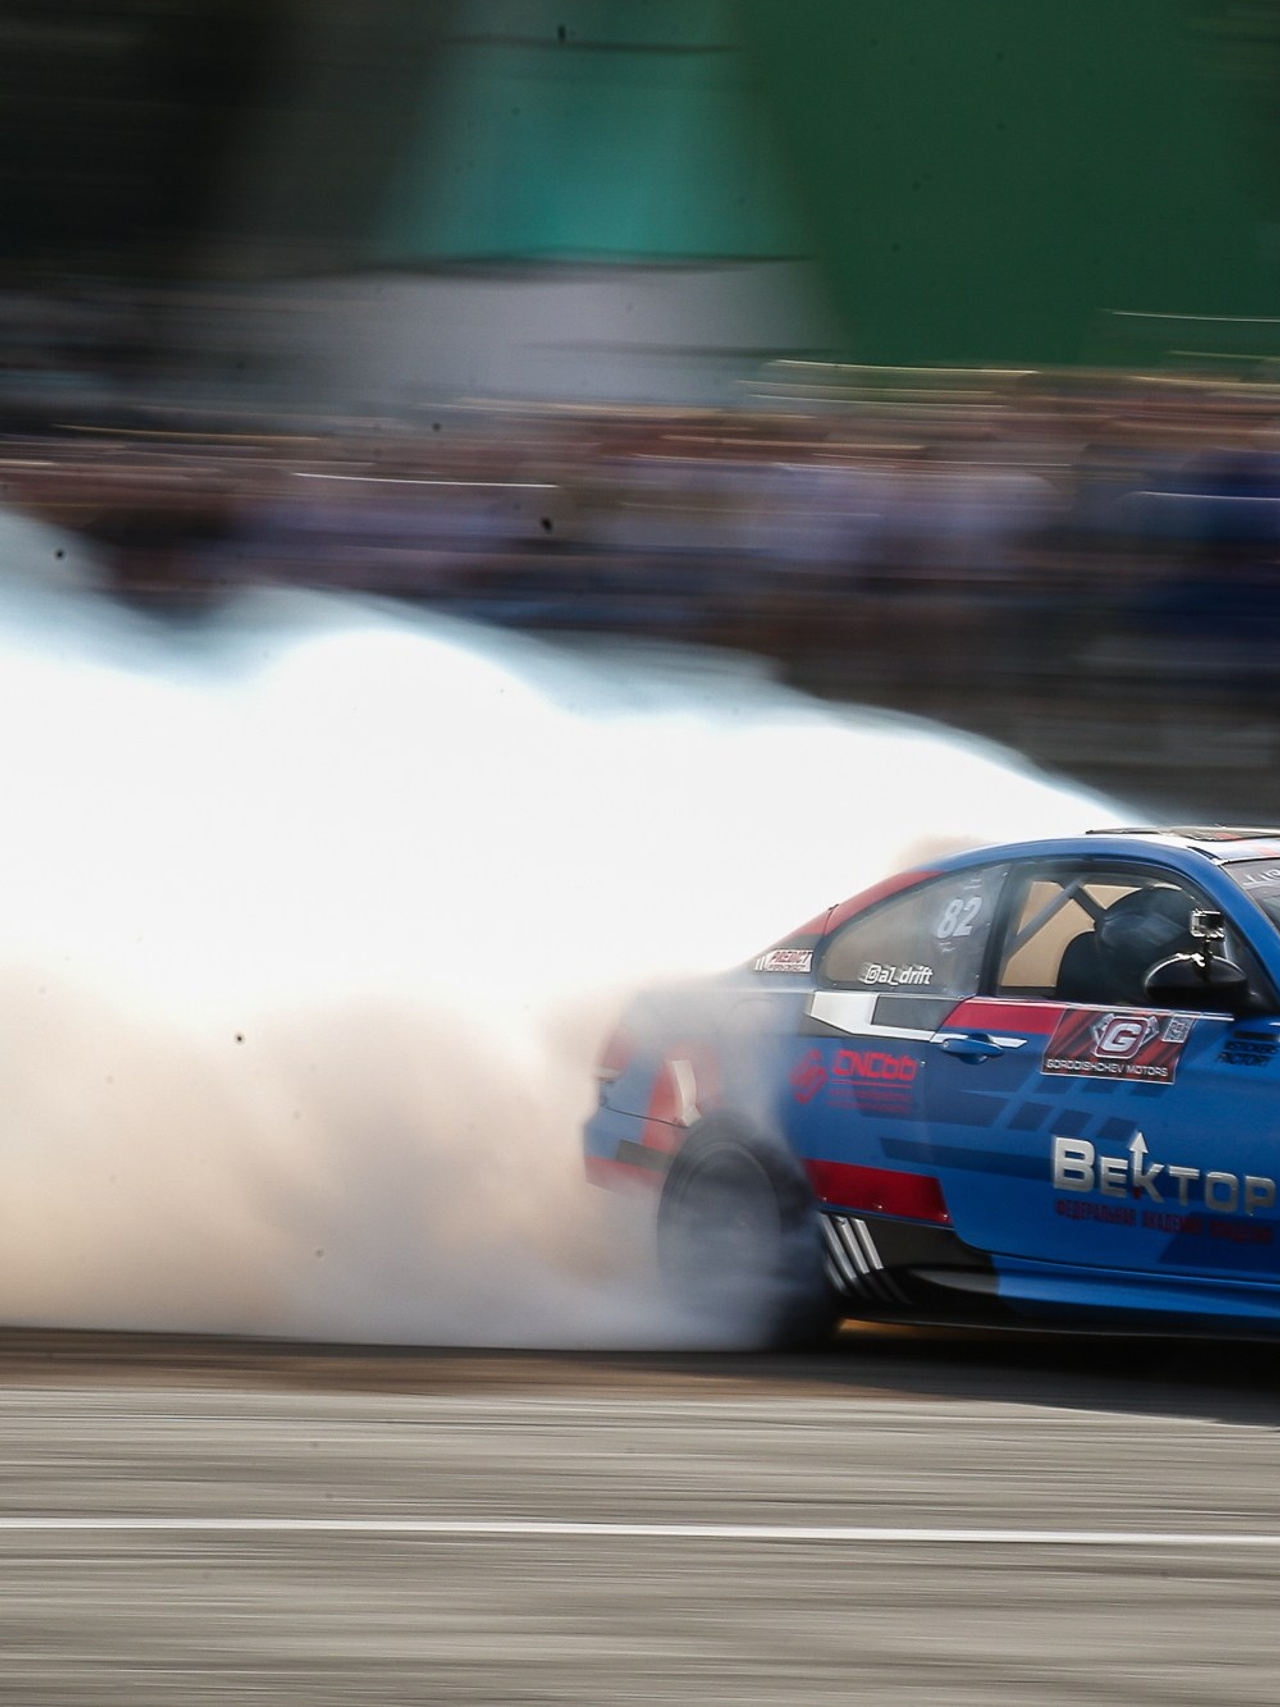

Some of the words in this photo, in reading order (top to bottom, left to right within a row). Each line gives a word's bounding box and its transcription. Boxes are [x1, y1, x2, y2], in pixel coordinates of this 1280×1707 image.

[937, 897, 983, 939] 82
[1100, 1022, 1143, 1052] G
[1046, 1058, 1125, 1074] GORODISHCHEV
[1126, 1065, 1169, 1077] MOTORS
